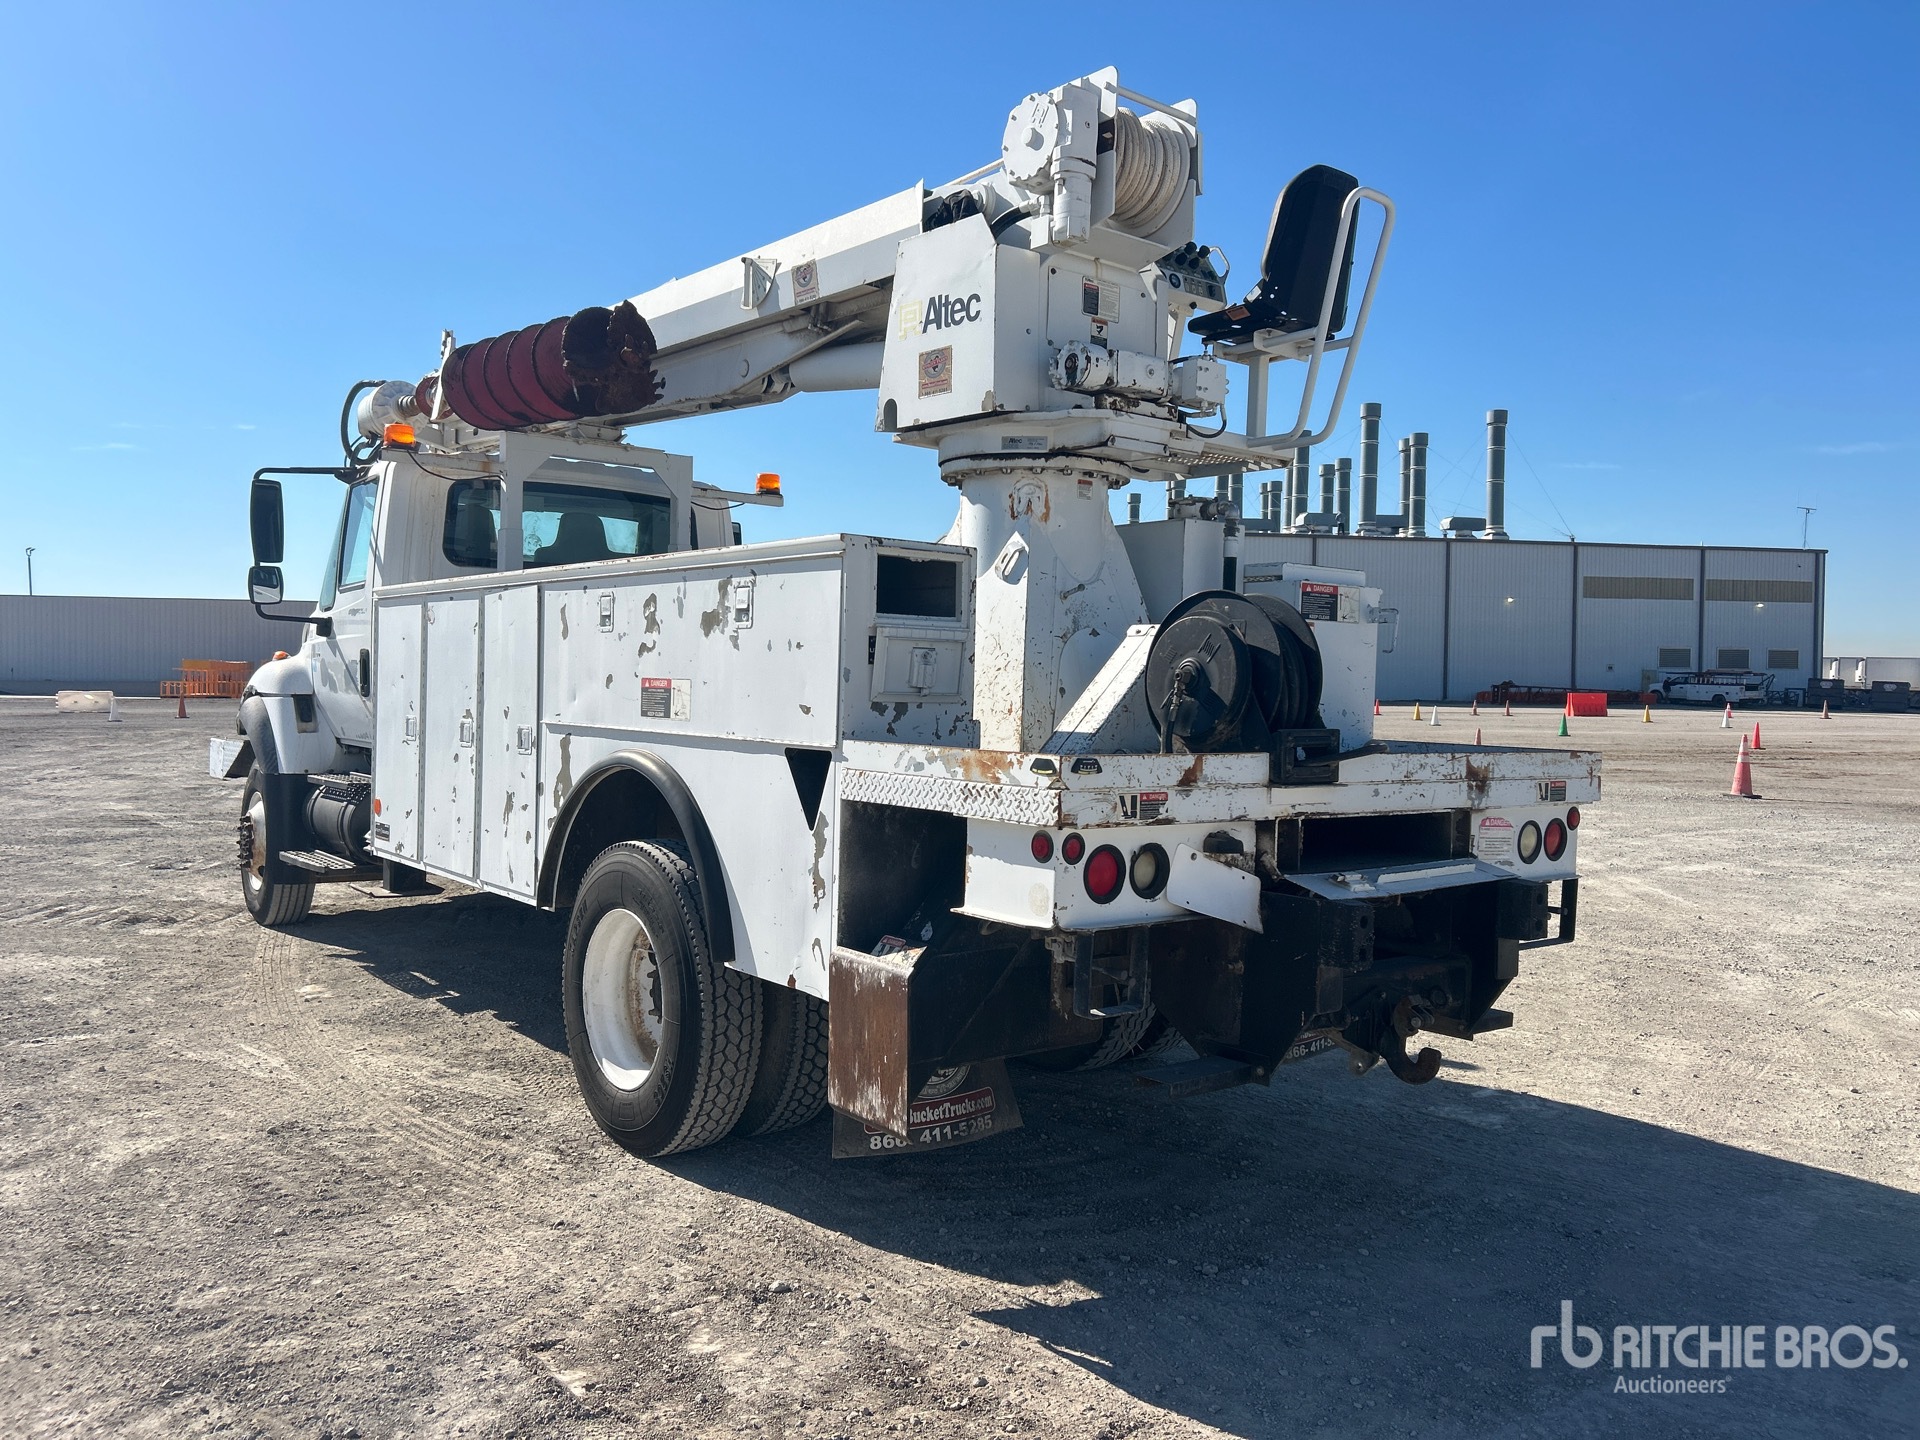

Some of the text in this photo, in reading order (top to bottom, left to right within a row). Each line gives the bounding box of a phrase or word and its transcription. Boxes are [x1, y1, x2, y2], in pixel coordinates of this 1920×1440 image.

[922, 293, 981, 334] Altec
[1313, 585, 1334, 593] DANGER
[650, 679, 668, 687] DANGER
[919, 1115, 993, 1144] 411-5285
